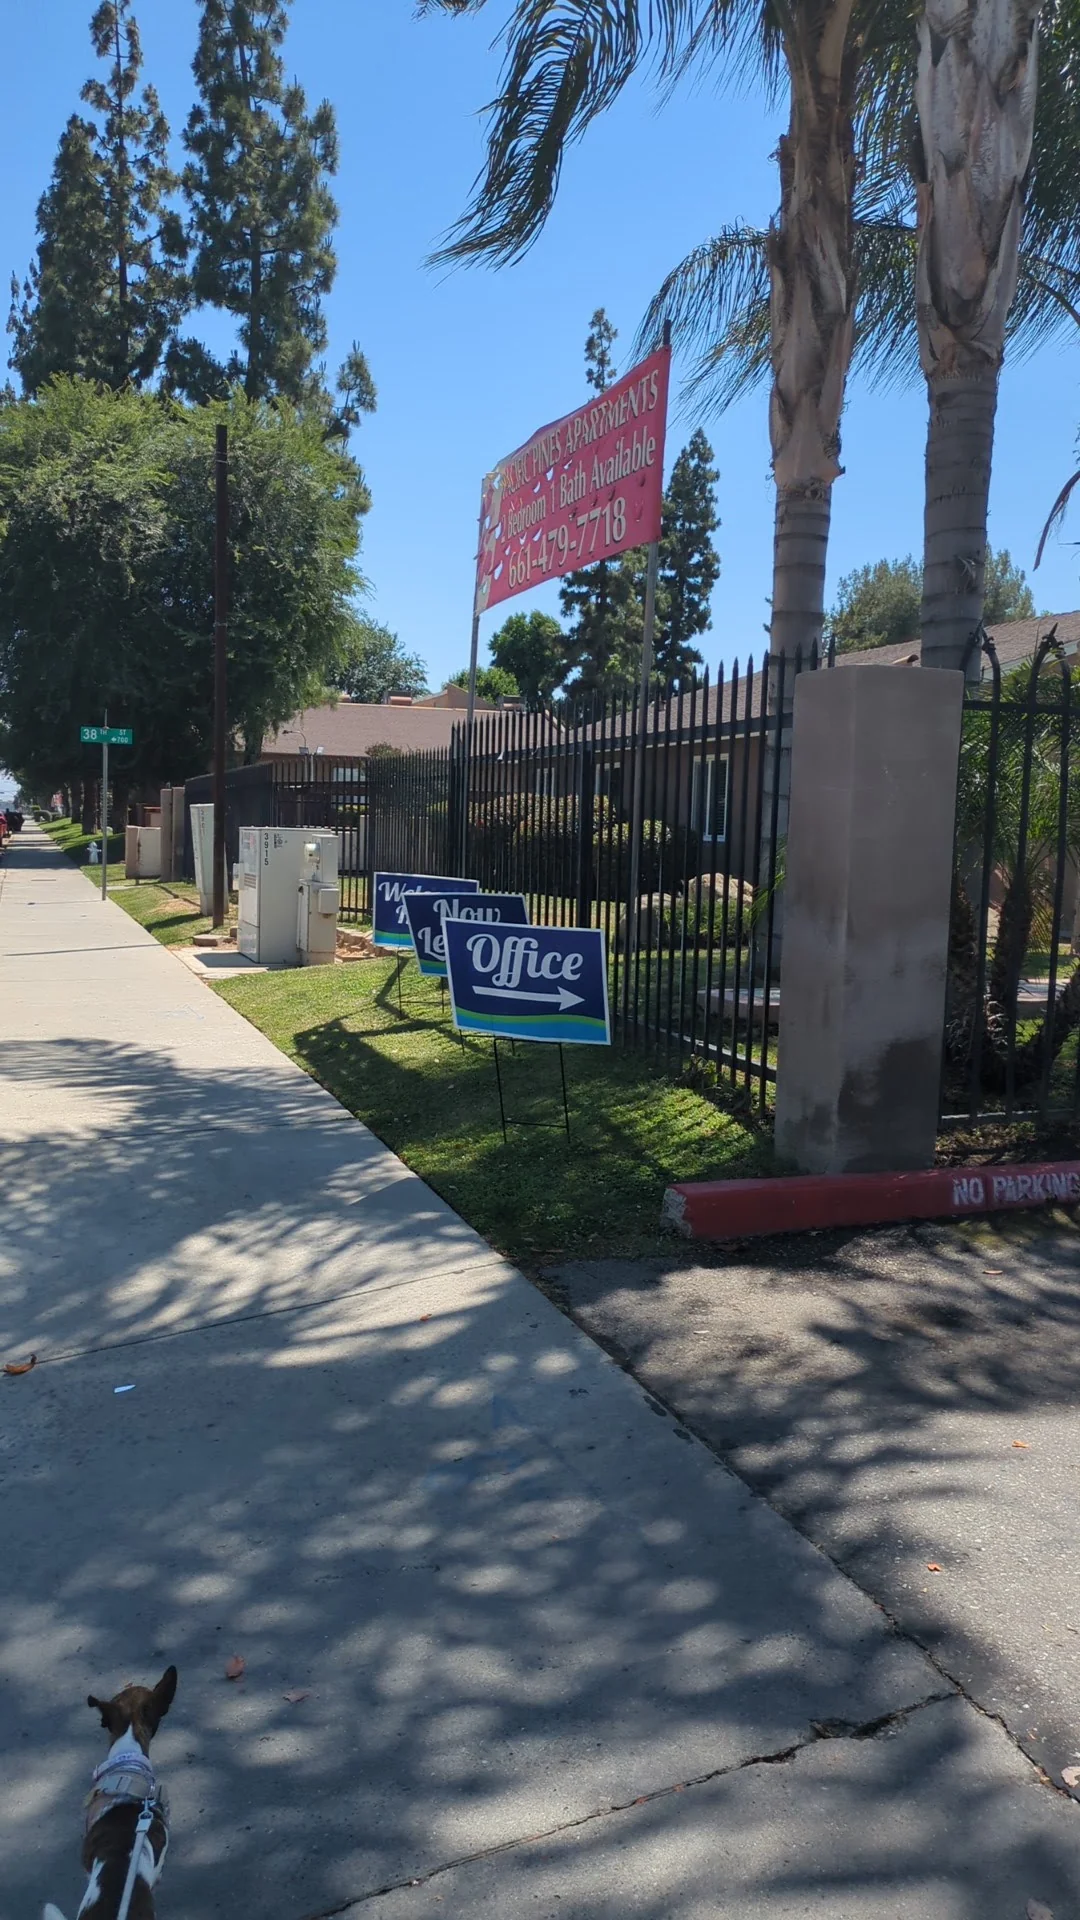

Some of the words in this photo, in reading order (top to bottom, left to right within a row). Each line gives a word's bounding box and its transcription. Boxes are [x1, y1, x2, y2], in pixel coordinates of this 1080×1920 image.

[532, 428, 562, 476] PINES
[563, 368, 660, 457] APARTMENTS
[550, 480, 555, 513] 1
[560, 461, 586, 509] Bath
[589, 425, 657, 497] Available
[508, 495, 627, 589] 661-479-7718
[466, 932, 585, 988] Office
[952, 1177, 985, 1206] NO
